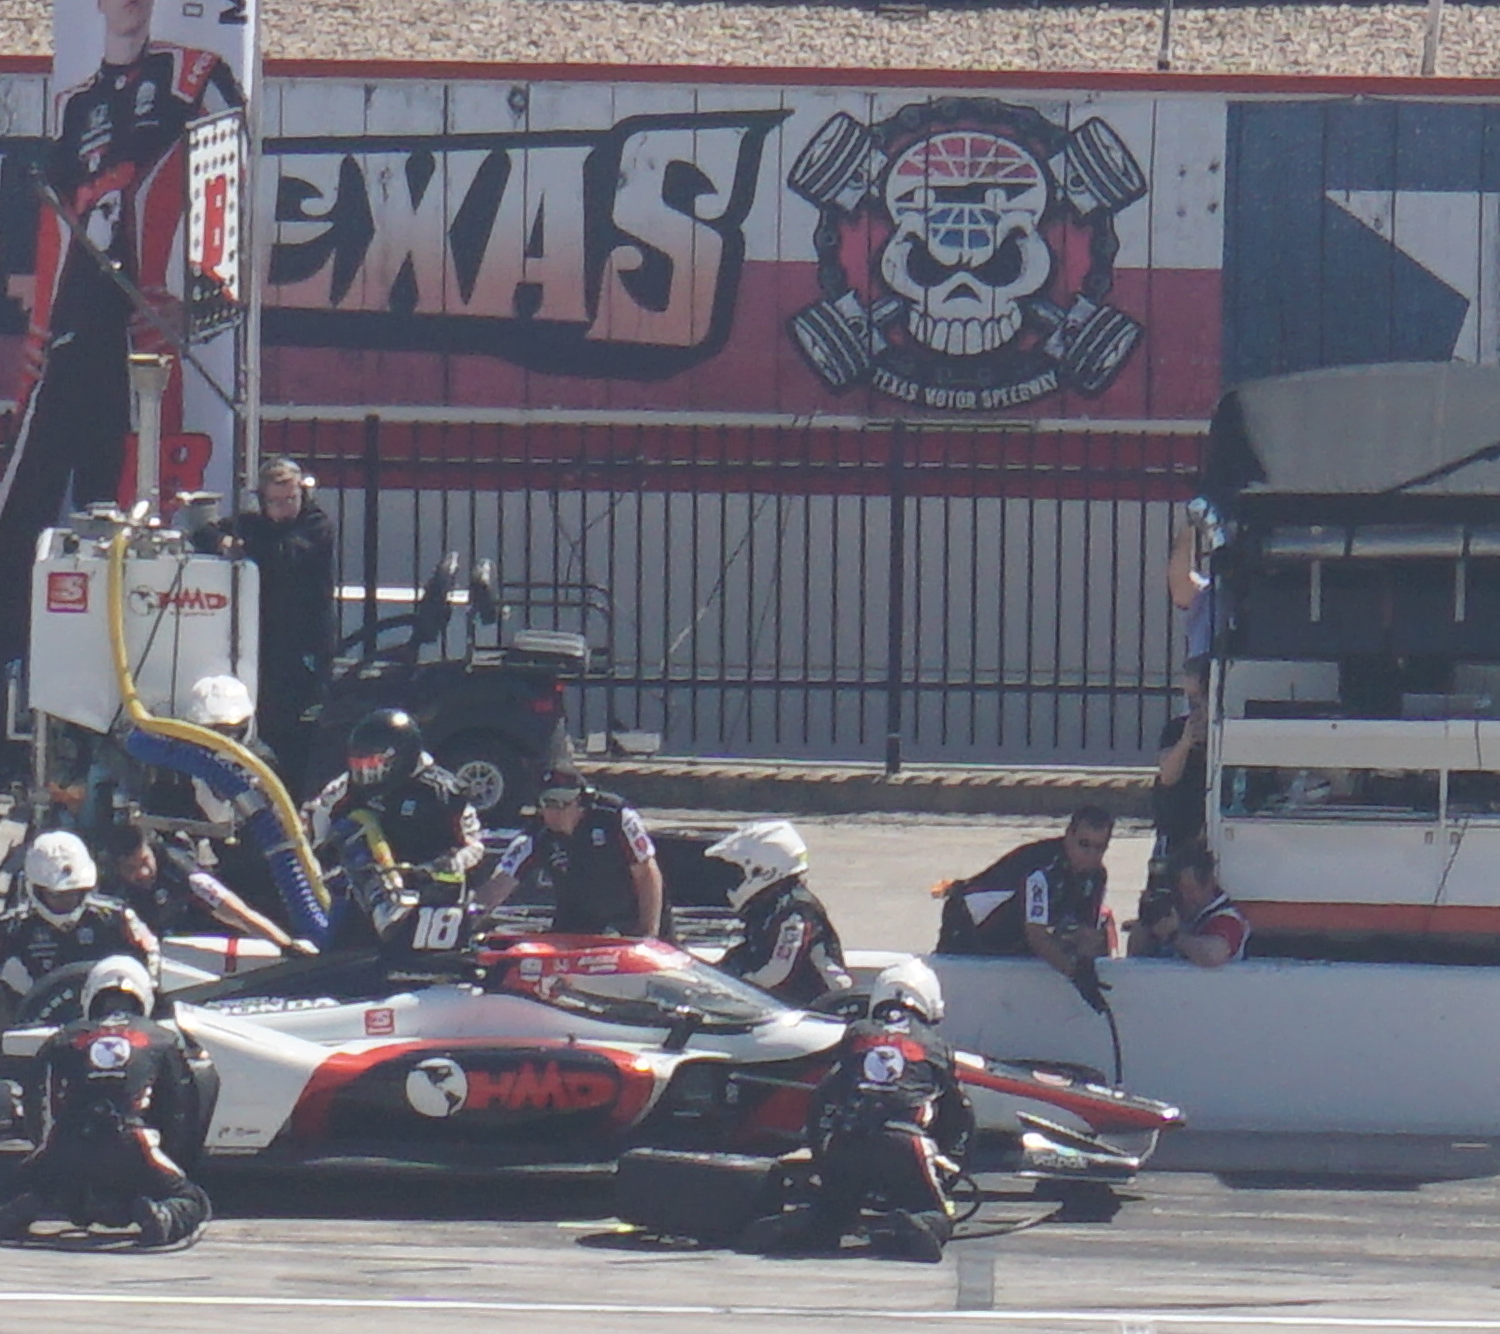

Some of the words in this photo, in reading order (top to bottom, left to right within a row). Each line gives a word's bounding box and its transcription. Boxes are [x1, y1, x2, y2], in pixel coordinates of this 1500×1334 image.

[263, 123, 756, 349] EXAS
[872, 366, 920, 402] TEXAS
[924, 386, 978, 410] MOTOR
[981, 369, 1060, 409] SPEEDWAY
[411, 906, 465, 951] 18
[467, 1060, 616, 1110] HMD
